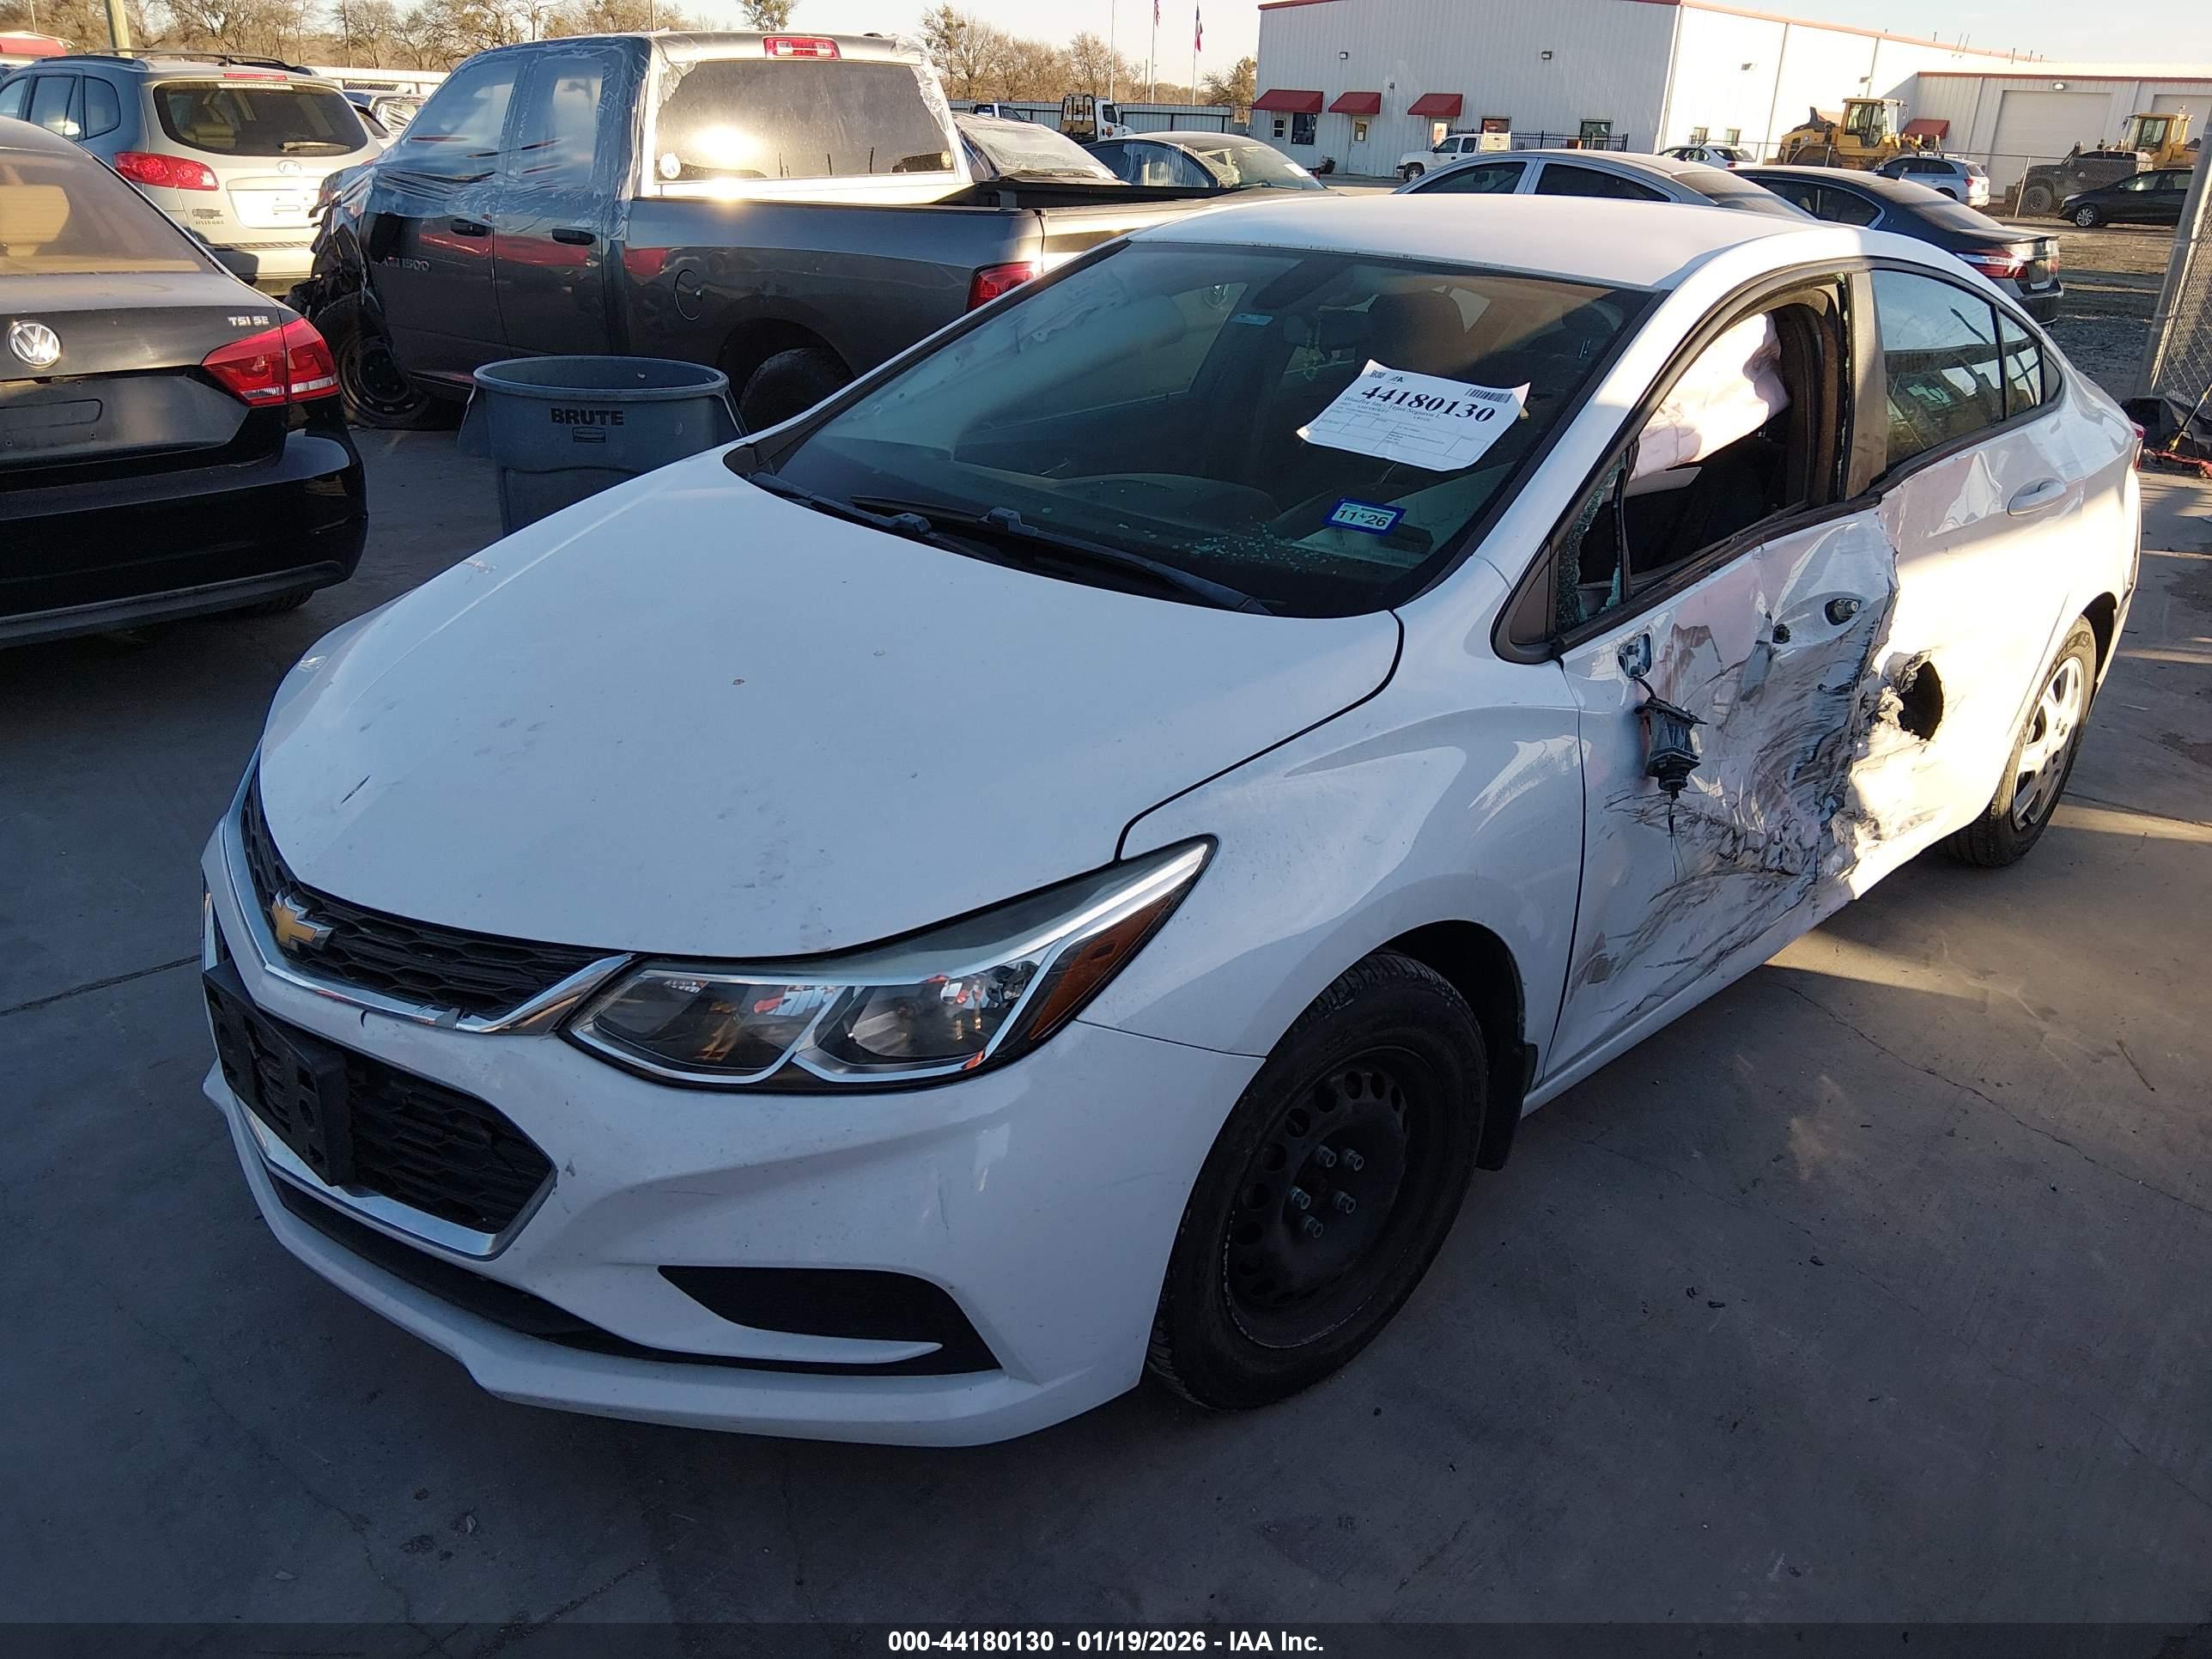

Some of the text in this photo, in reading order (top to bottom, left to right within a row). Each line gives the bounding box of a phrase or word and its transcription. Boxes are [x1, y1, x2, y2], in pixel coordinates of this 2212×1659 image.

[253, 315, 270, 326] SE
[1361, 386, 1496, 422] 44180130
[550, 408, 625, 426] BRUTE
